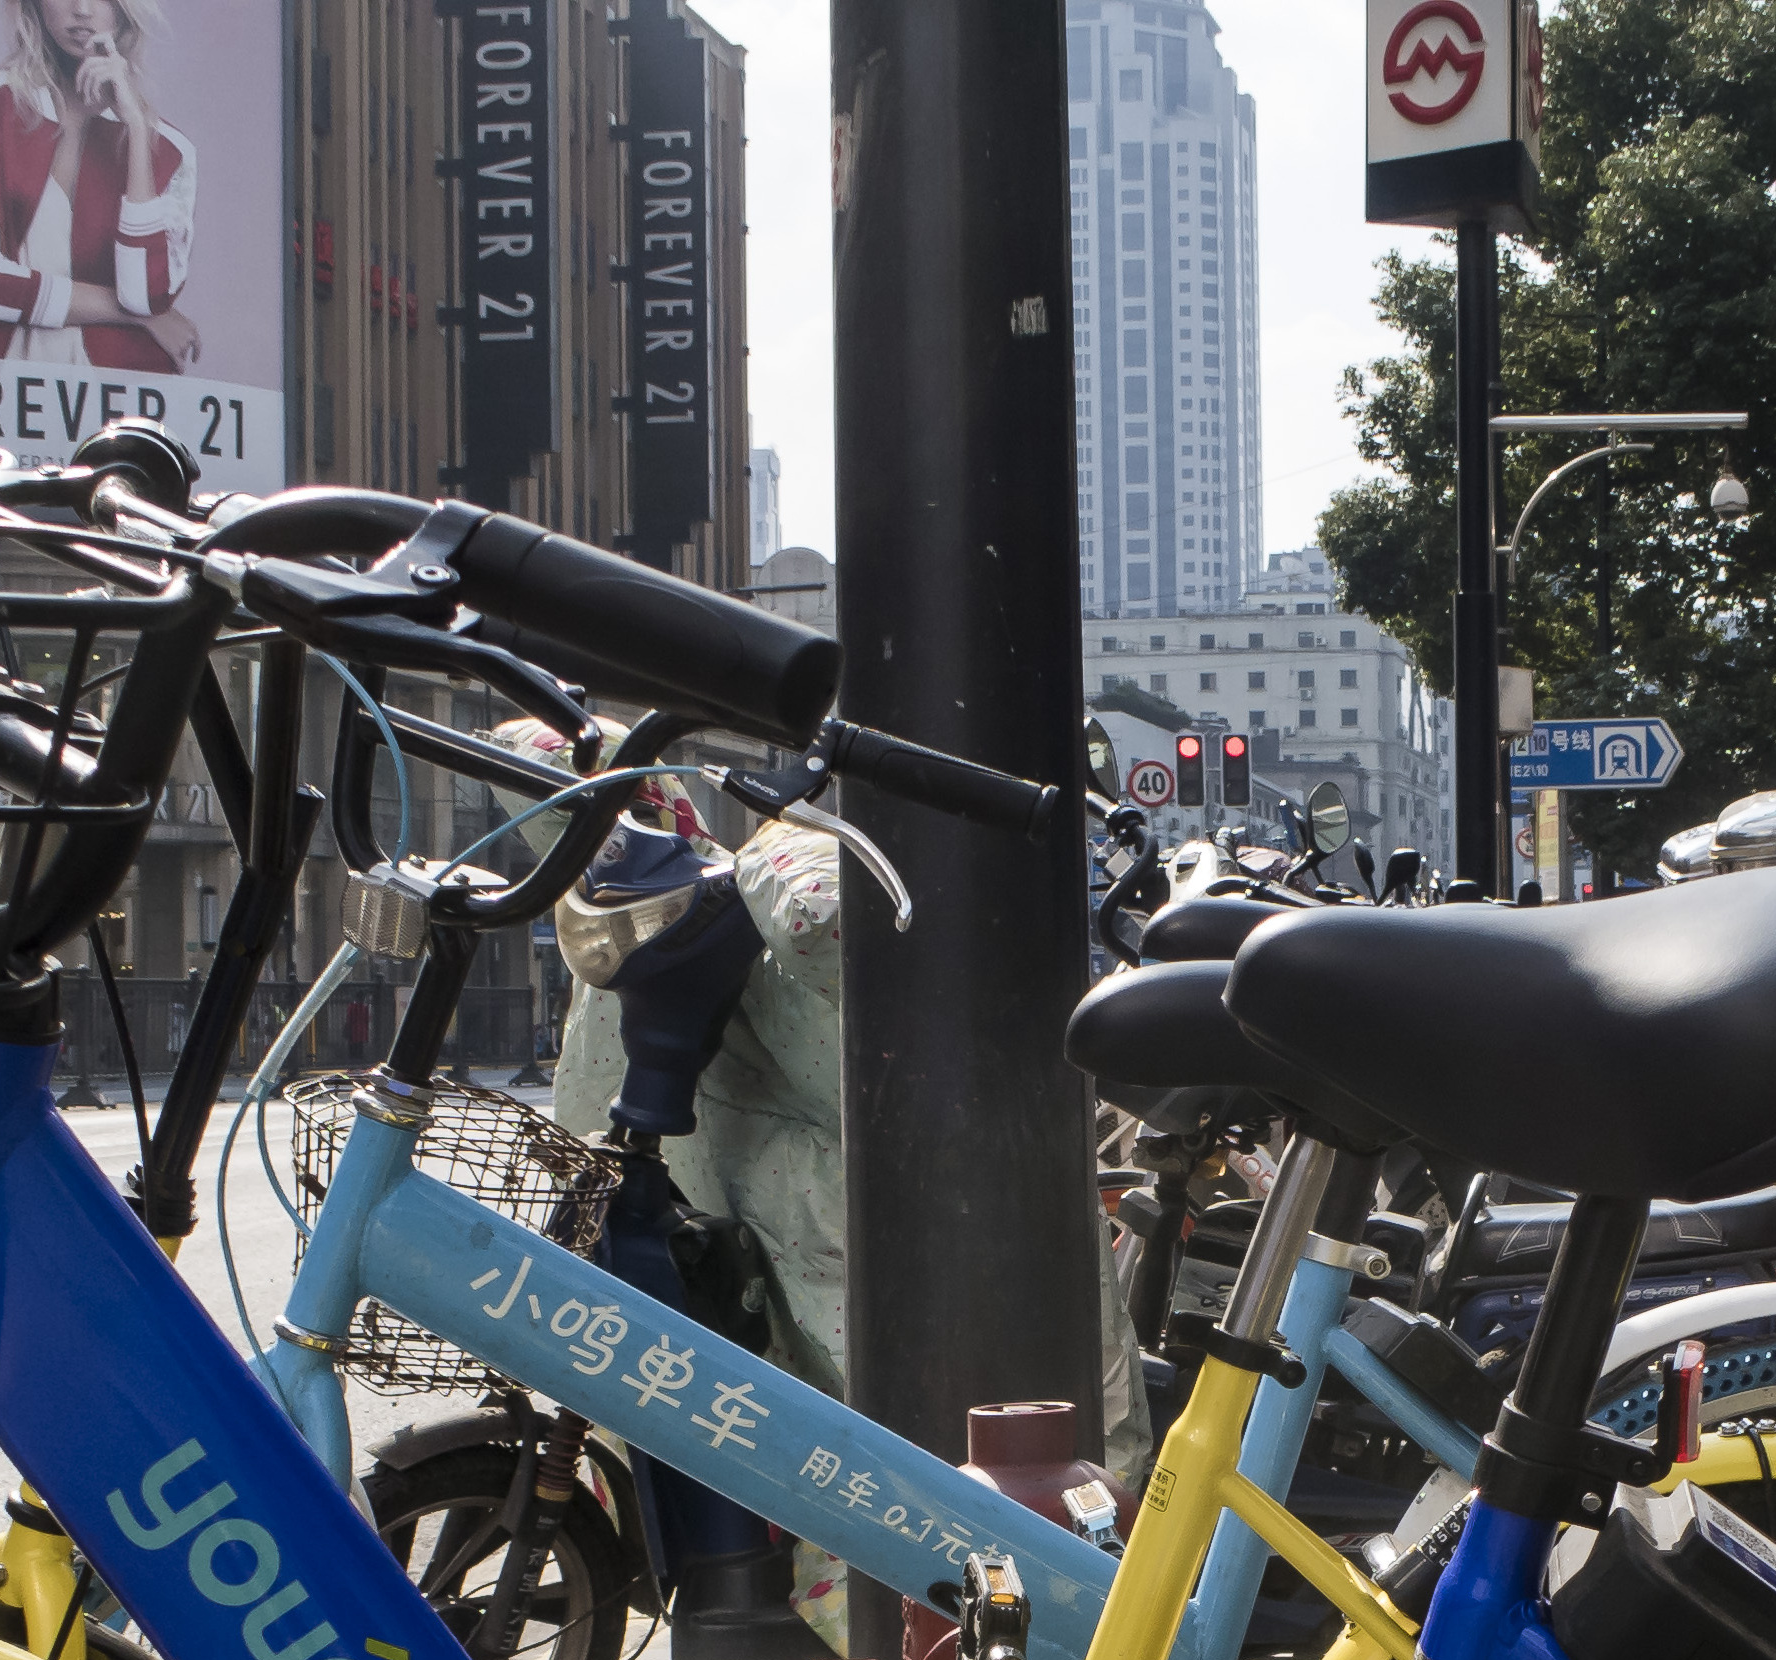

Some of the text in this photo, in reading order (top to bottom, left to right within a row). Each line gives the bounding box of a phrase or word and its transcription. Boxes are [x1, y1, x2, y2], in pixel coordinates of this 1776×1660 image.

[474, 4, 535, 344] FOREVER 21
[642, 129, 695, 425] FOREVER 21
[199, 395, 245, 460] 21
[1137, 771, 1166, 797] 40
[1532, 735, 1548, 753] 10
[1551, 729, 1592, 752] 号线
[469, 1256, 771, 1450] 小鸣单车
